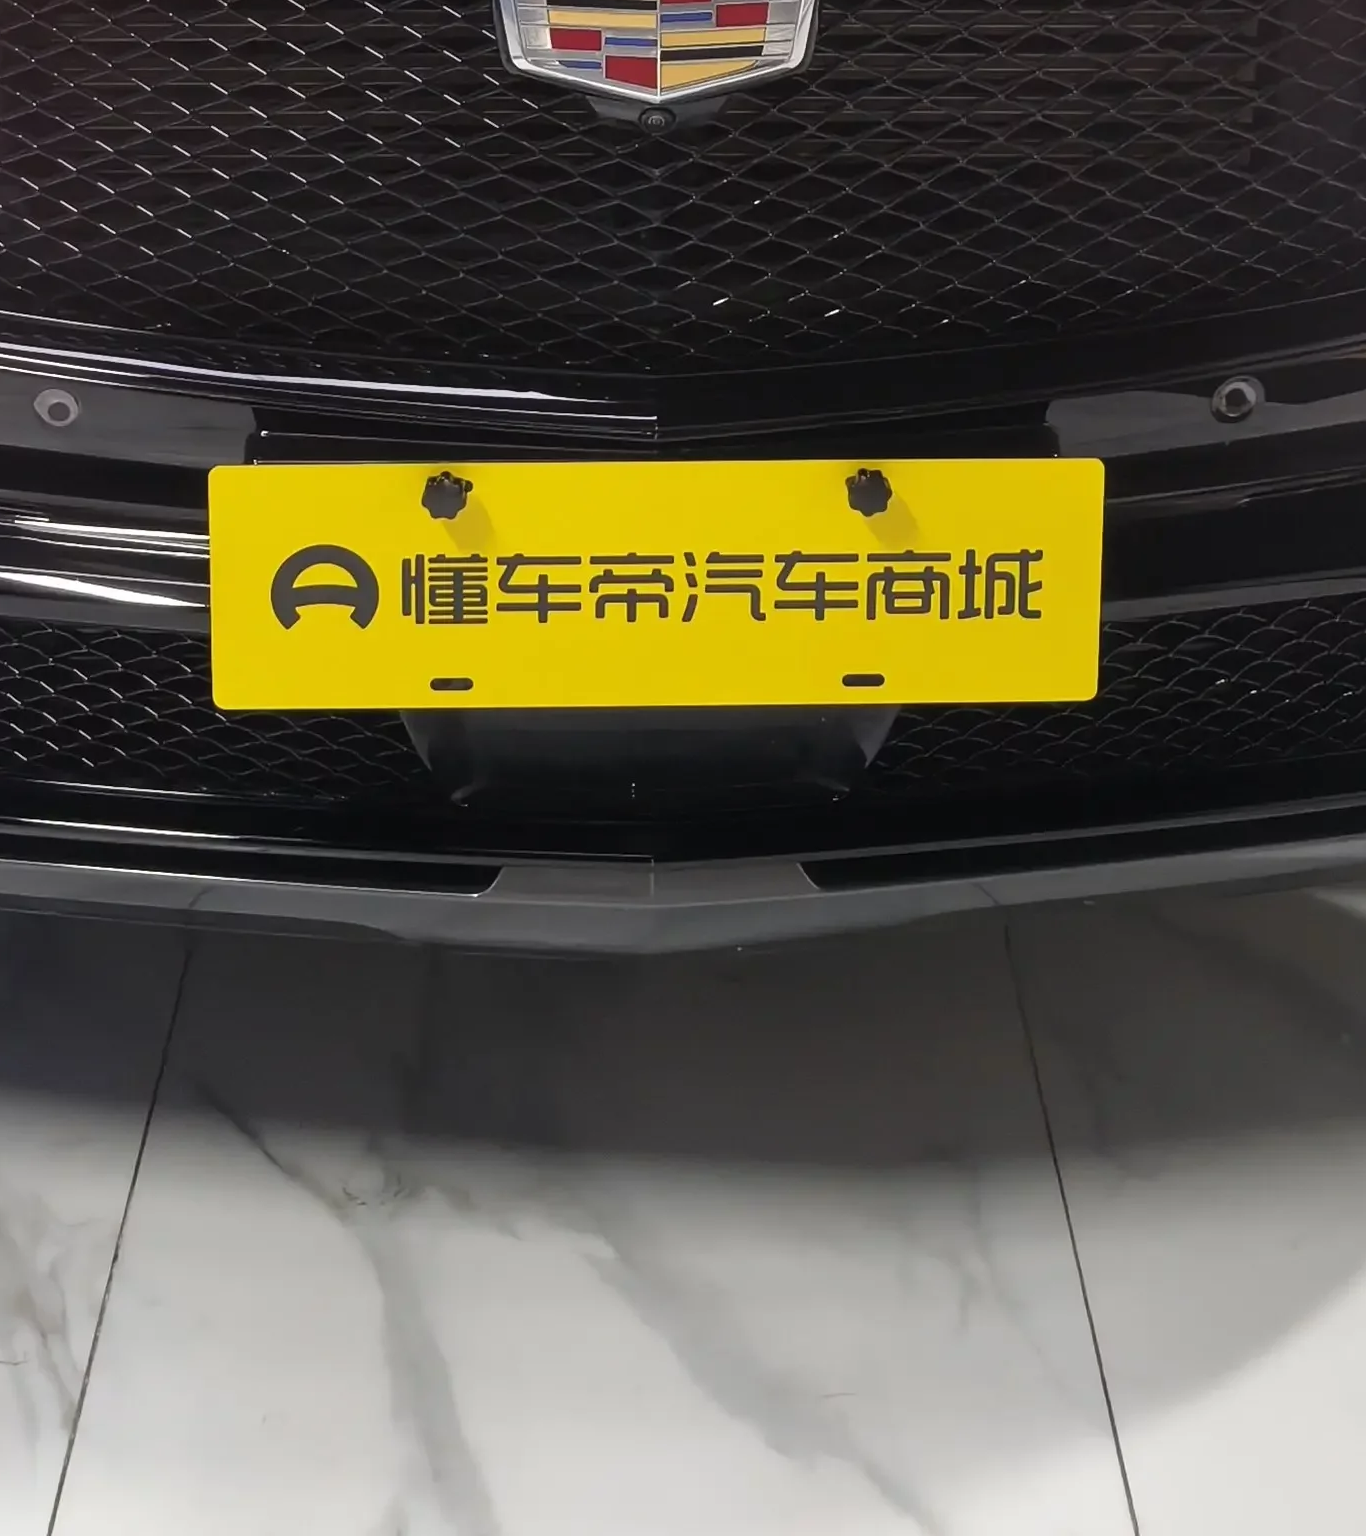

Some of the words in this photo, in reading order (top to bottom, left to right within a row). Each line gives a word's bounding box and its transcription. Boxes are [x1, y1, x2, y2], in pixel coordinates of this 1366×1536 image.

[400, 549, 1044, 626] 懂车帝汽车商城
